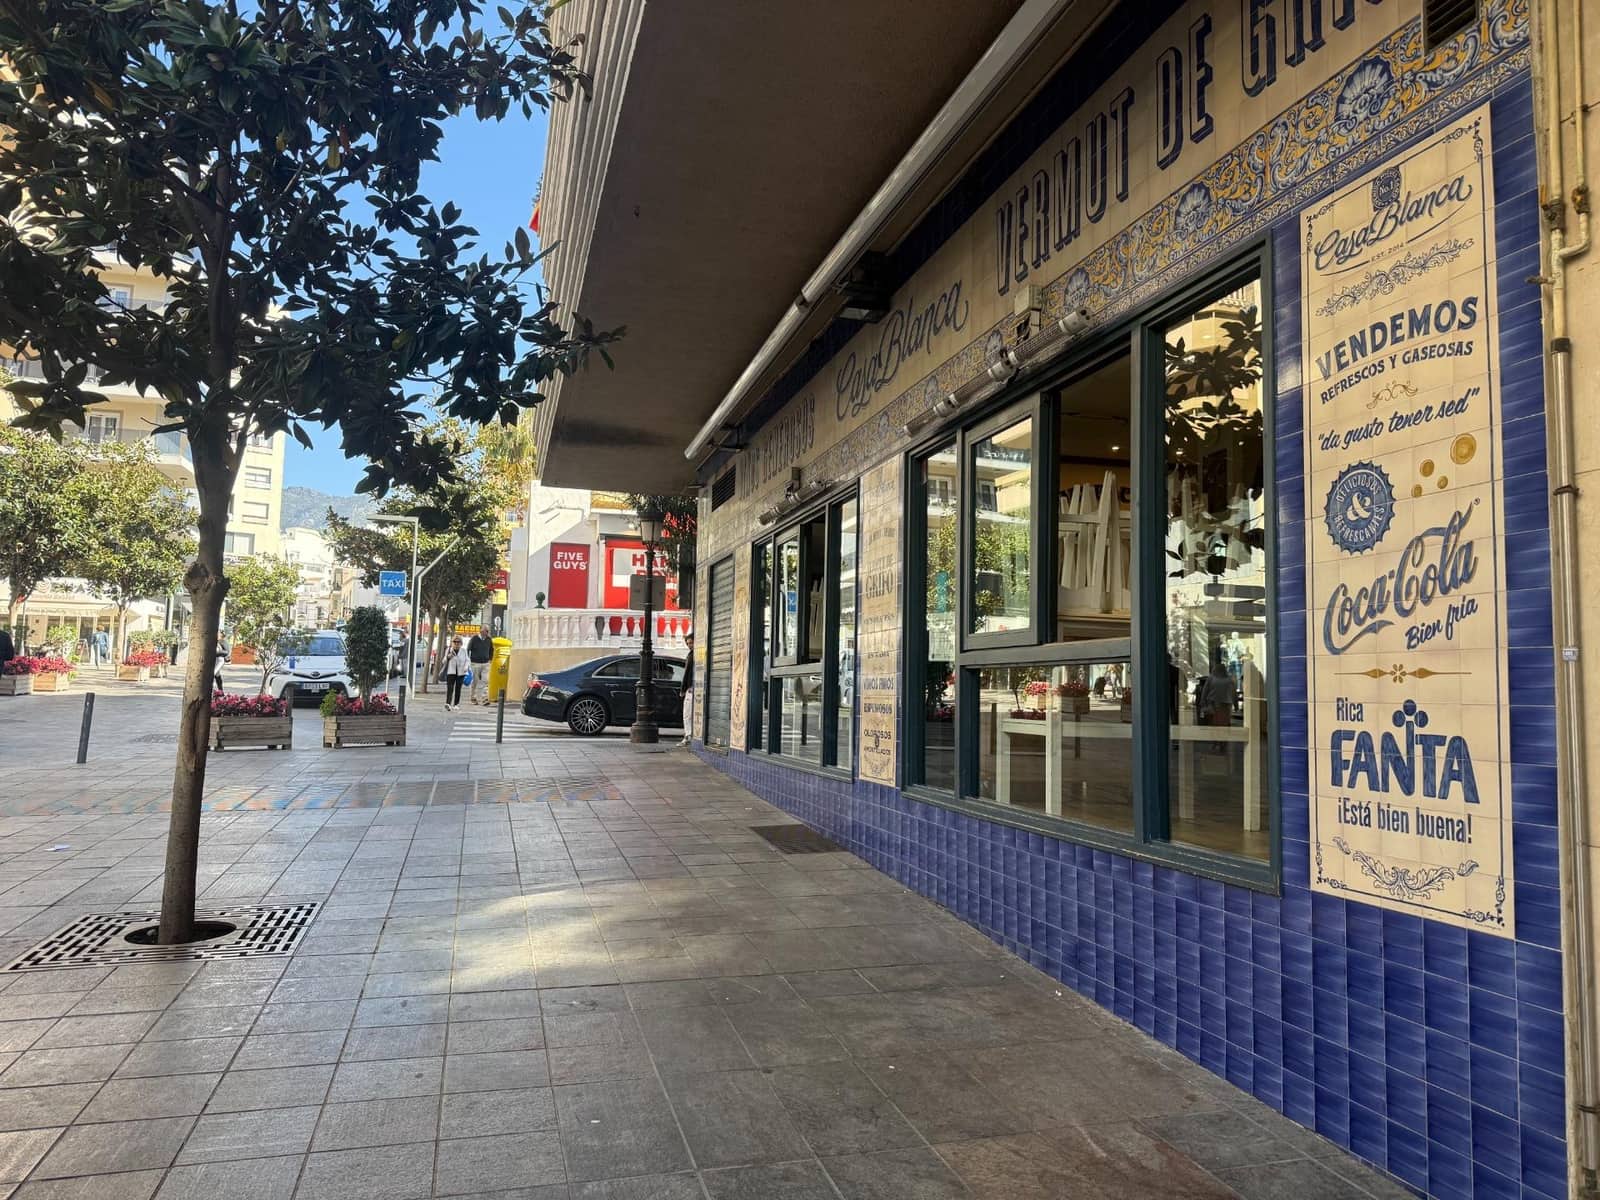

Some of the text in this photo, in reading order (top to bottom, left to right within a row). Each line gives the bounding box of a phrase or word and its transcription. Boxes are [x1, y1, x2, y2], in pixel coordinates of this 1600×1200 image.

[995, 87, 1135, 298] VERMUT
[1155, 12, 1214, 171] DE
[1315, 295, 1479, 381] VENDEMOS
[1320, 340, 1474, 405] REFRESCOS Y GASEOSAS
[1343, 417, 1385, 450] gusto
[1388, 404, 1434, 431] tener
[1346, 492, 1372, 521] &
[553, 560, 587, 571] GUYS
[556, 551, 584, 562] FIVE
[383, 579, 405, 588] TAXI
[865, 568, 894, 600] GRIFO
[1322, 500, 1479, 656] Coca-Cola
[1405, 619, 1443, 650] Bien
[1336, 697, 1364, 723] Rica
[1330, 719, 1480, 805] FANTA
[1337, 797, 1473, 844] ¡Está bien buena!
